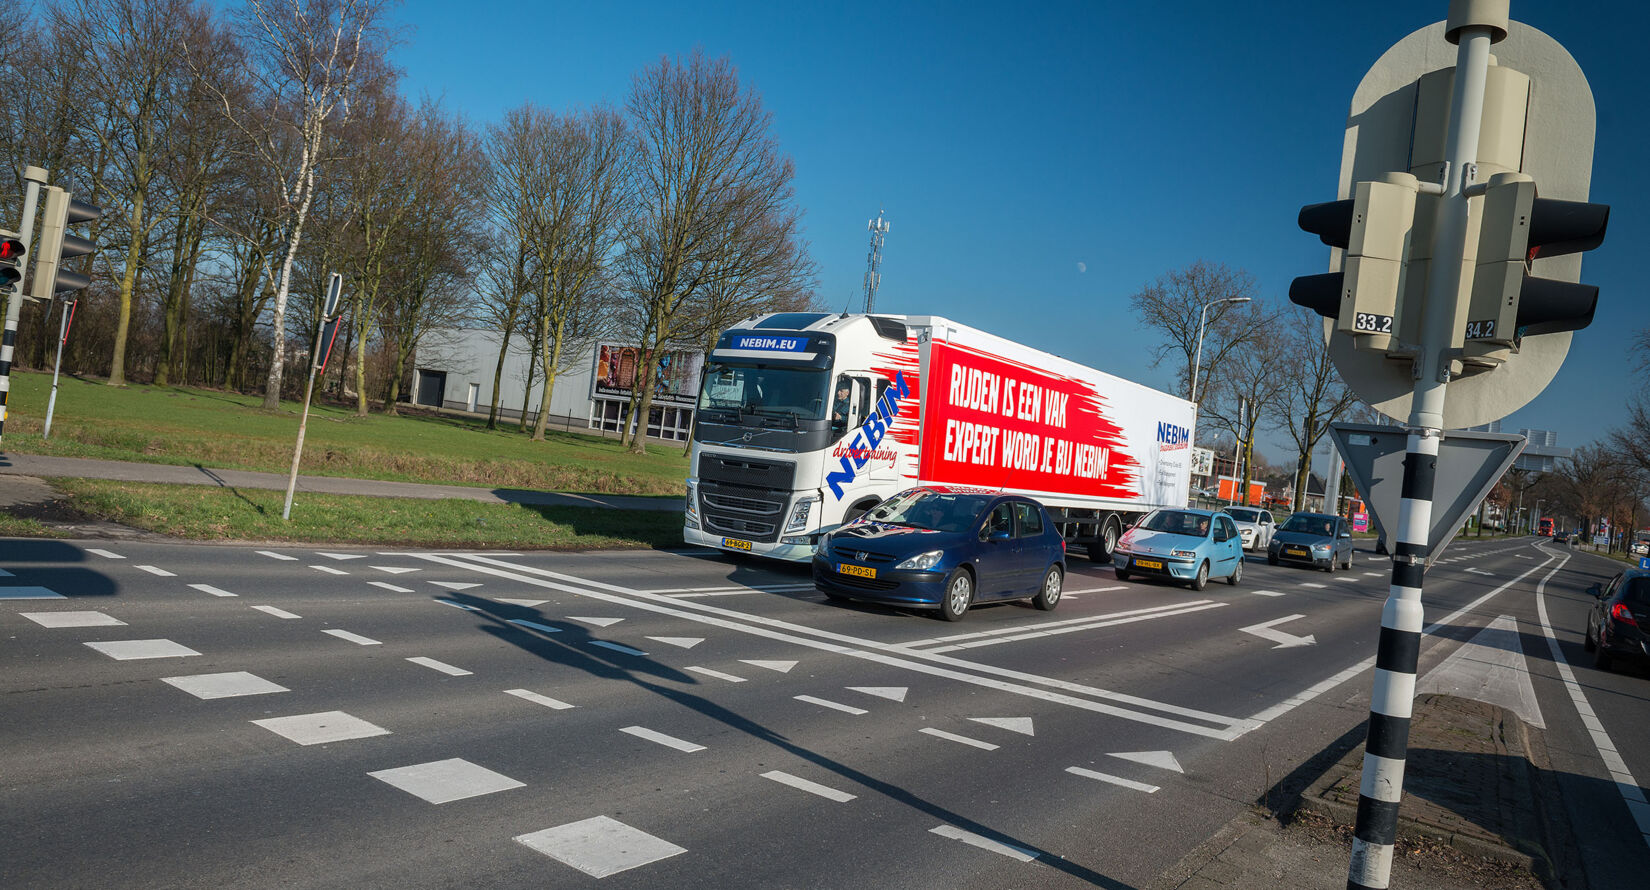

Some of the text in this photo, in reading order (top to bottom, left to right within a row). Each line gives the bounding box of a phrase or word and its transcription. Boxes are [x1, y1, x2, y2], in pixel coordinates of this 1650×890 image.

[1357, 314, 1392, 332] 33.2
[1466, 321, 1495, 338] 34.2
[739, 337, 797, 350] NEBIM.EU
[949, 363, 1069, 429] RIJDEN IS EEN VAK
[826, 370, 911, 501] NEBIM
[1157, 421, 1189, 445] NEBIM
[832, 441, 898, 469] drivertraining
[943, 418, 1110, 480] EXPERT WORD JE BIJ NEBIM!
[841, 564, 874, 577] 69-PD-SL
[1642, 560, 1649, 569] L
